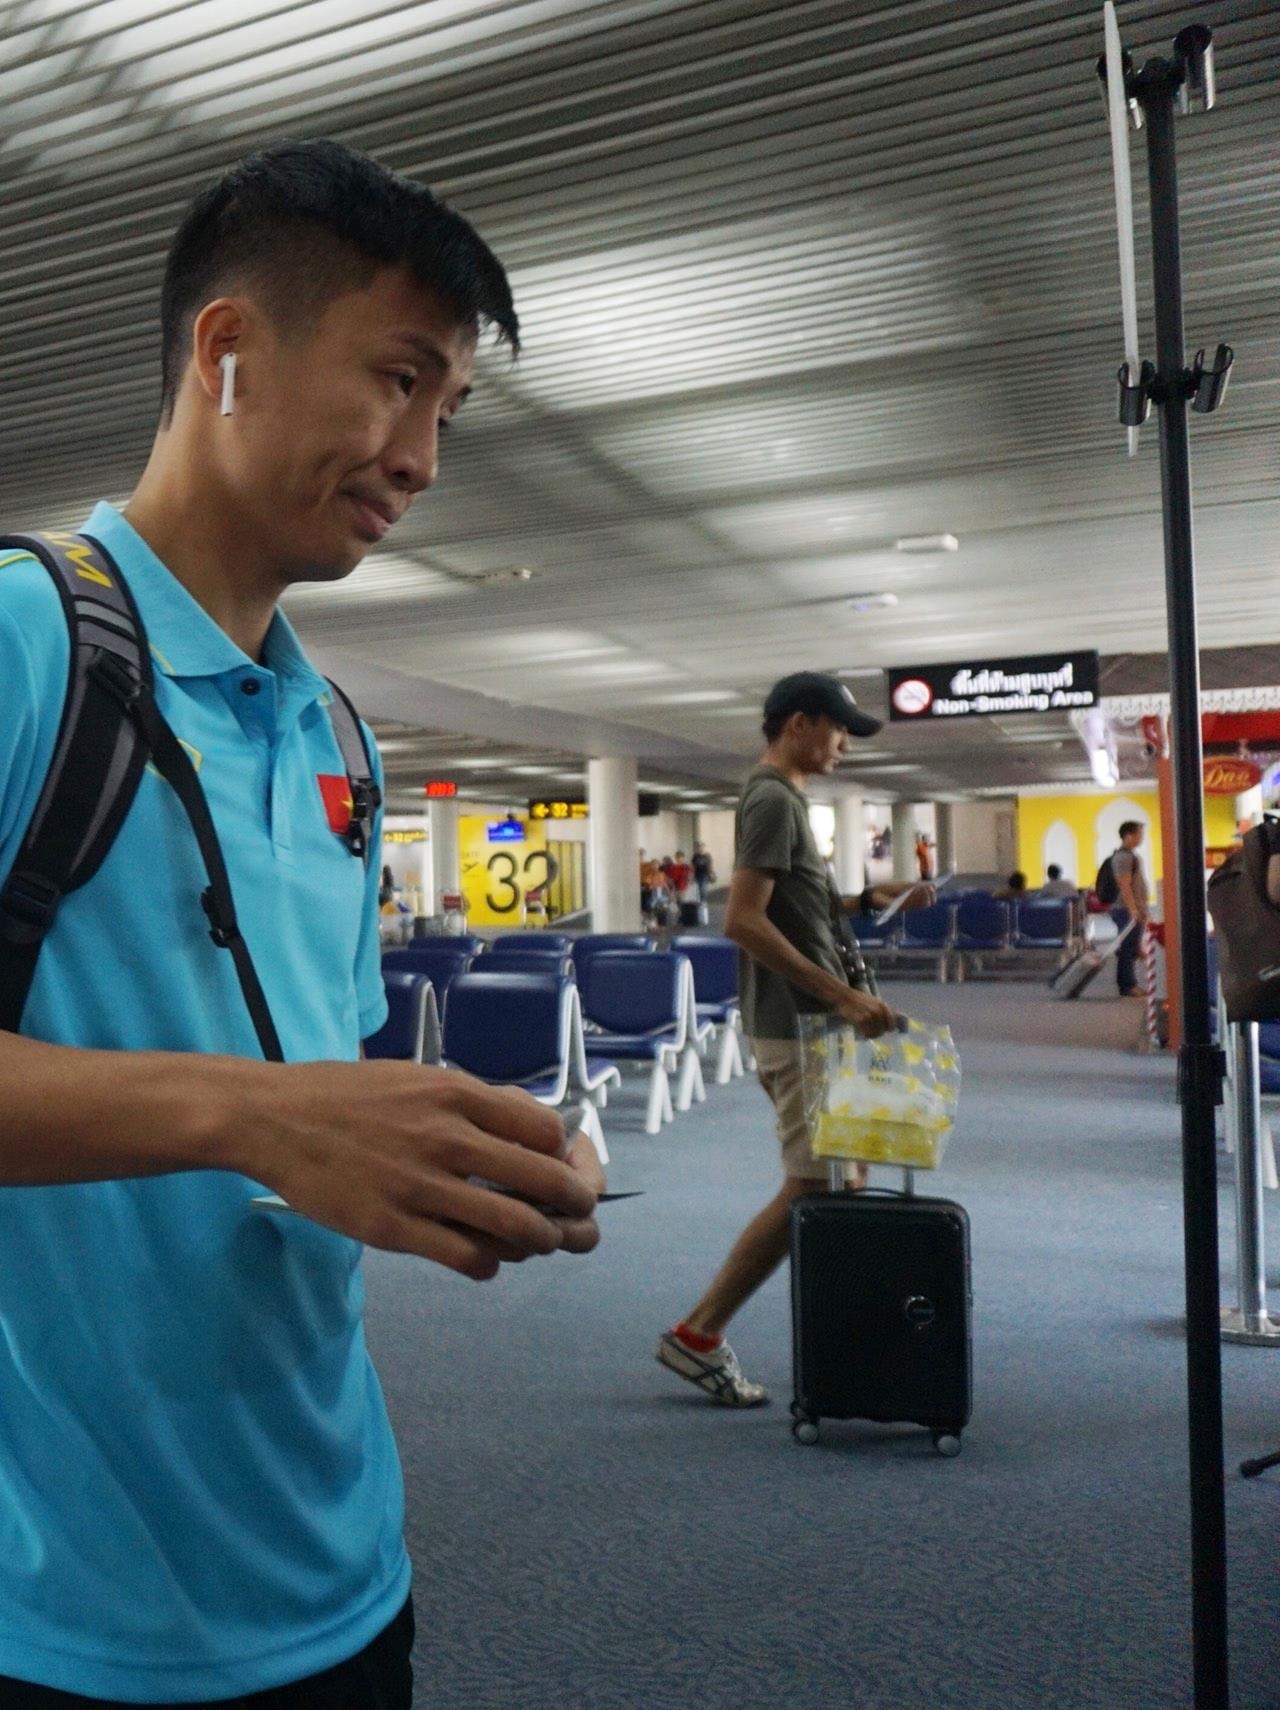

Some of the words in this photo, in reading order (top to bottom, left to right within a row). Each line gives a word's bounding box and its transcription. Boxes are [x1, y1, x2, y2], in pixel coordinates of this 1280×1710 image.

[932, 694, 1049, 715] Non-Smoking
[1051, 690, 1094, 706] Area
[486, 851, 558, 913] 32
